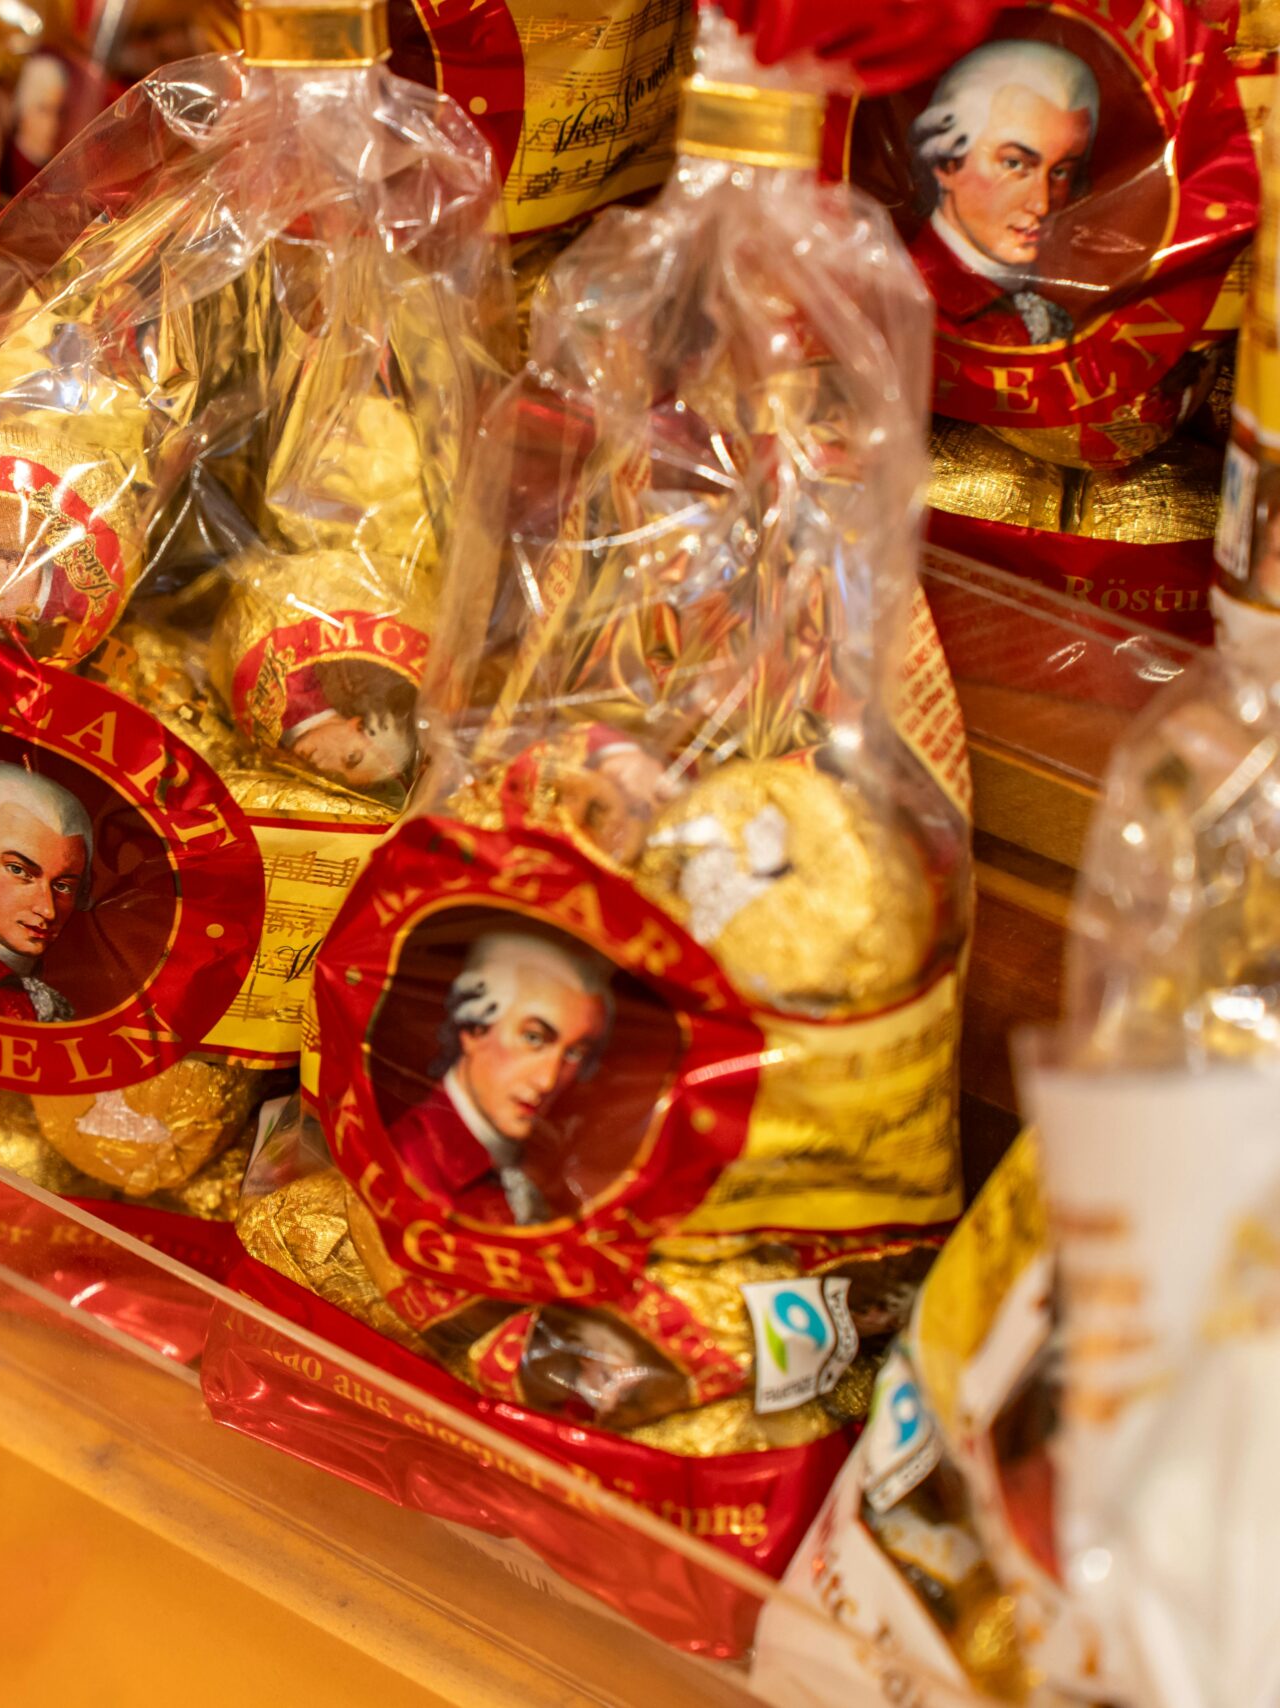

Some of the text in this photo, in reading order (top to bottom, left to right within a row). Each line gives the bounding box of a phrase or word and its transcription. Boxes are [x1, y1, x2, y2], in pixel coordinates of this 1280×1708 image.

[540, 92, 624, 158] Victor
[333, 1373, 395, 1420] aus
[566, 1462, 768, 1548] Rtung
